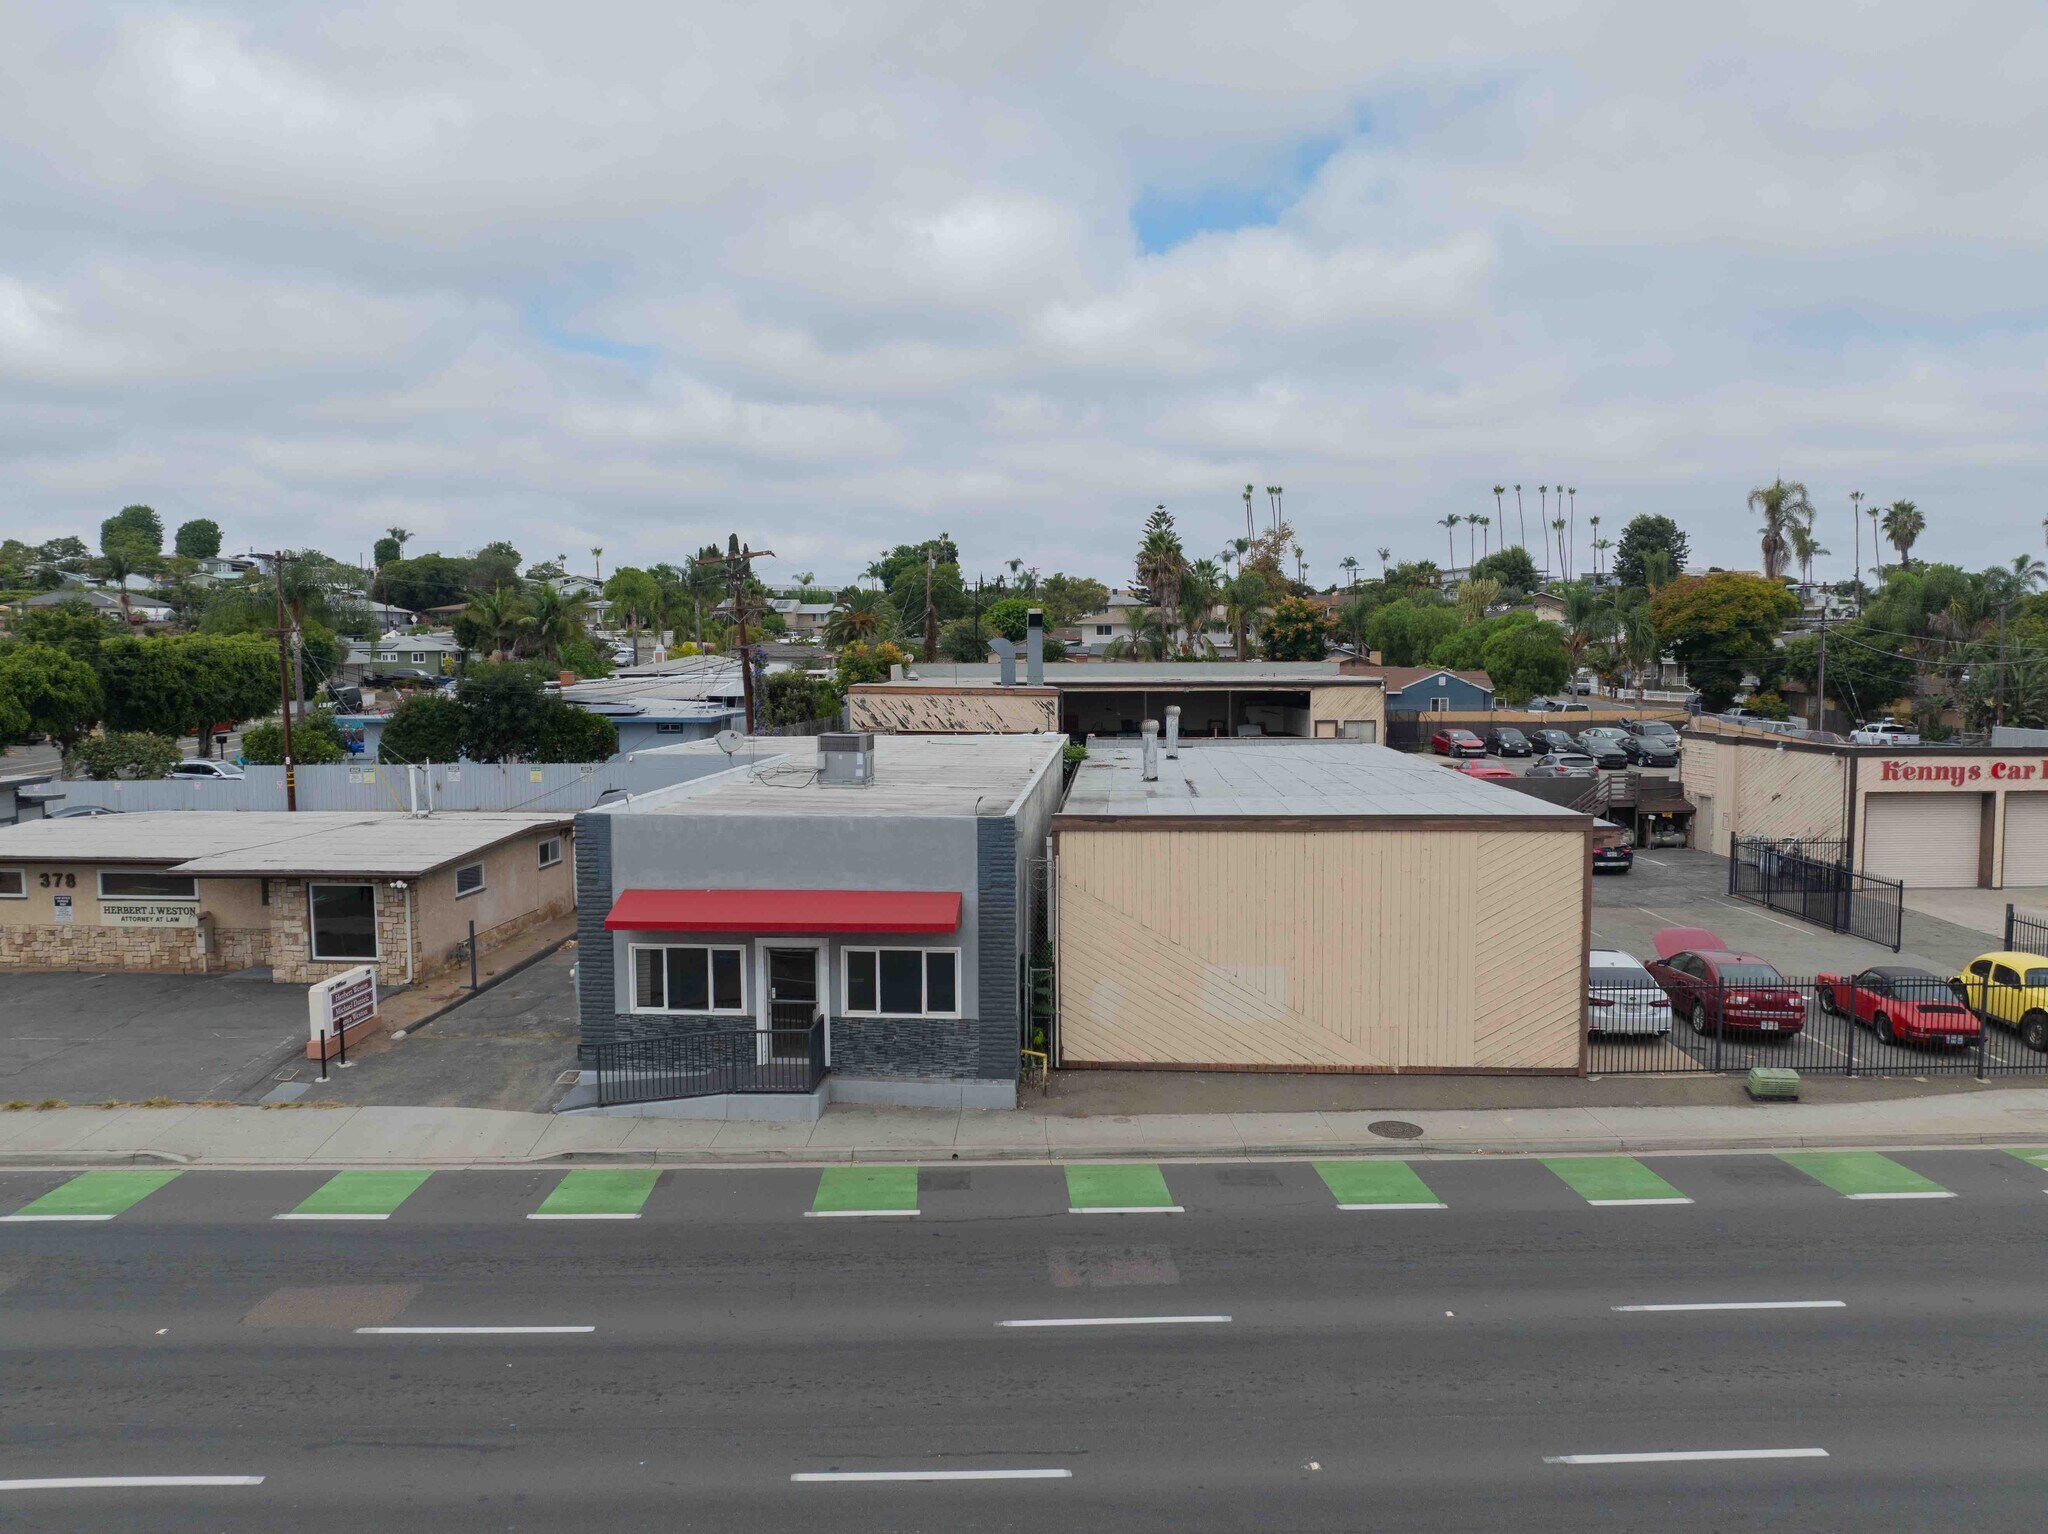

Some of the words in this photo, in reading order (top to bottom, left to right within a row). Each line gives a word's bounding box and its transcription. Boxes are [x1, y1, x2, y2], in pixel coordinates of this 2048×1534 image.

[1880, 760, 1981, 787] Kennys
[1990, 761, 2036, 780] Car
[39, 872, 76, 889] 378
[103, 906, 147, 915] HERBERT
[157, 906, 196, 915] WESTON
[335, 989, 353, 1001] Herbert
